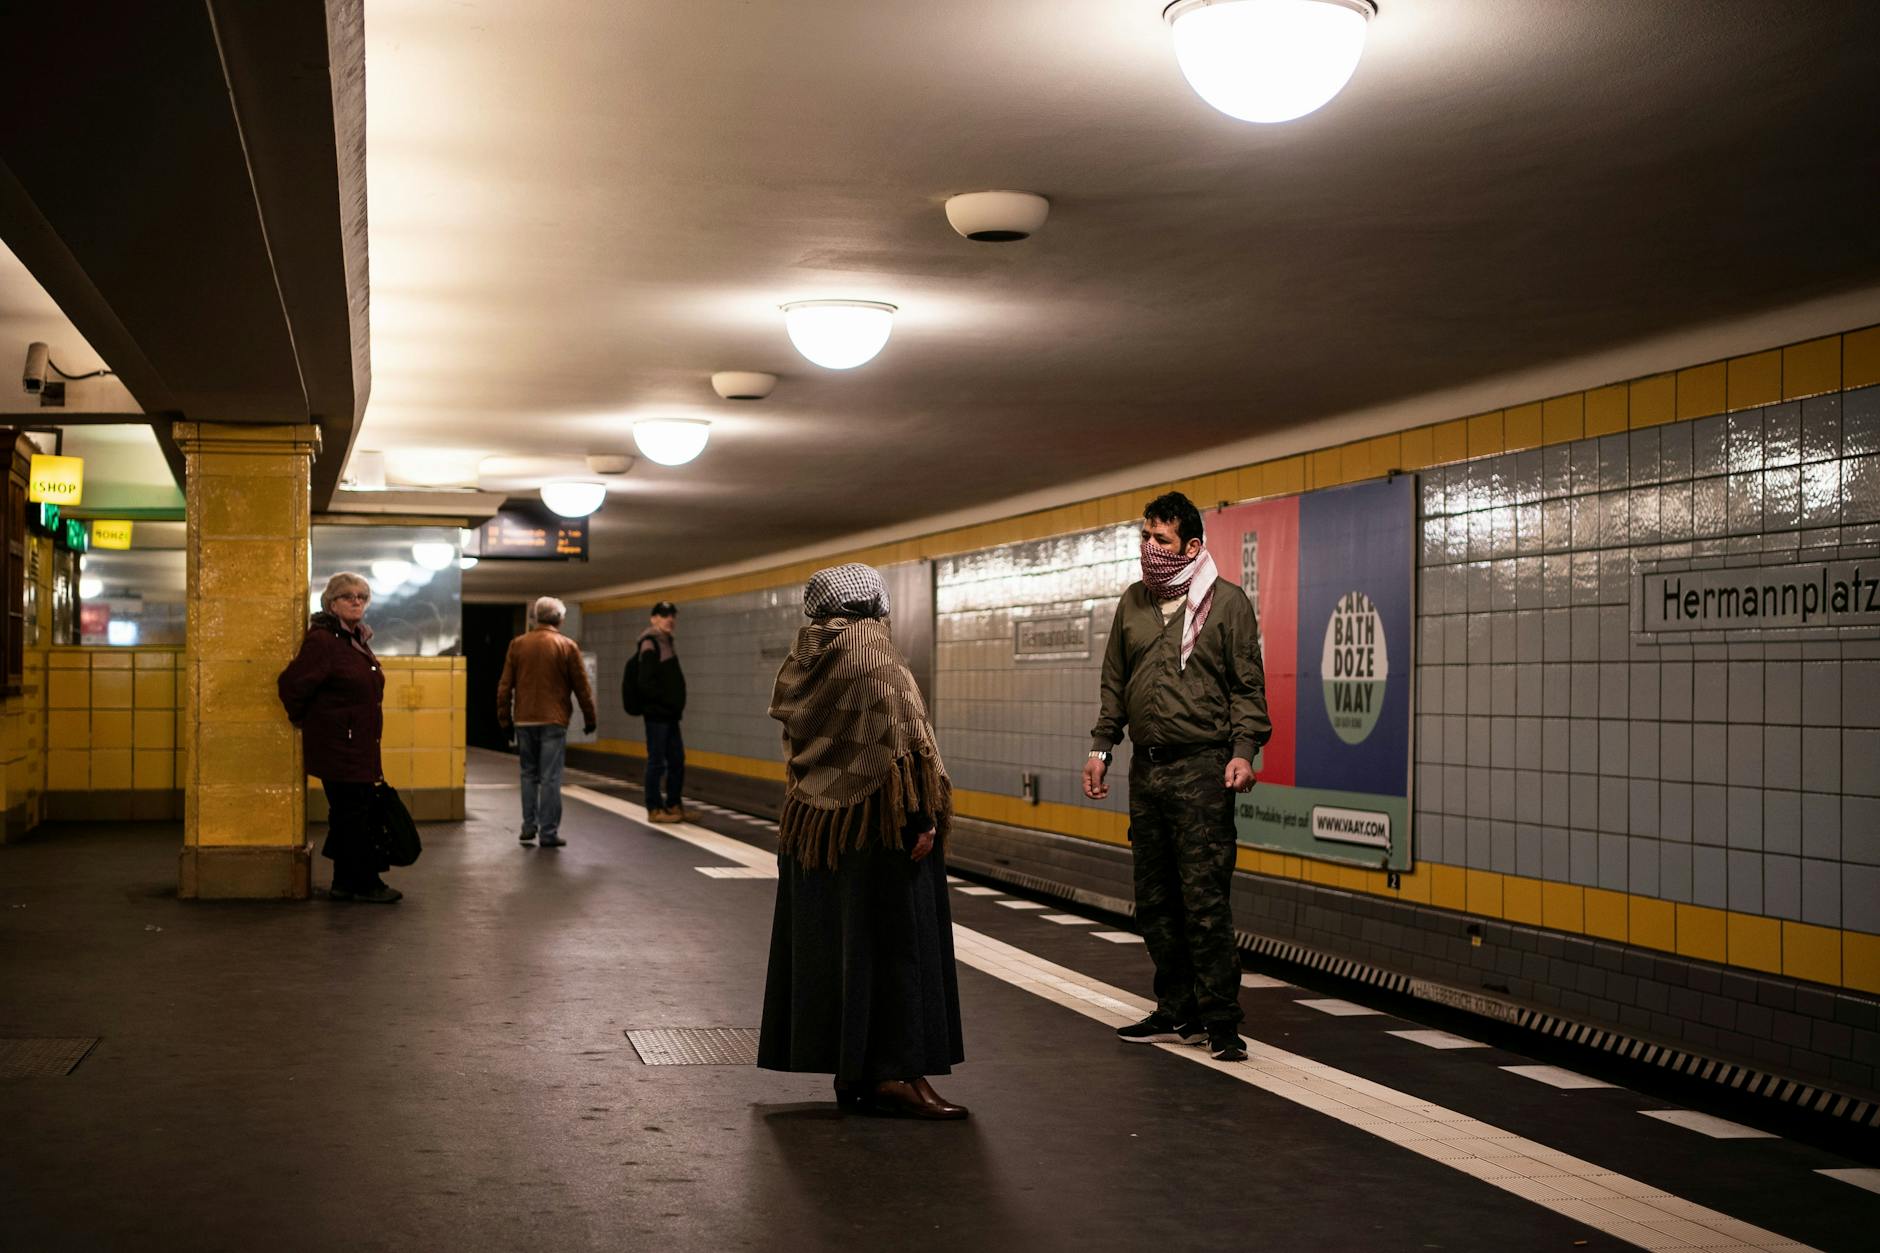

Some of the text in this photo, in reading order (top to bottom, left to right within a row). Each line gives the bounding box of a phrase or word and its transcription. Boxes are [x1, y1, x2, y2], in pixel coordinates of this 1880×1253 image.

[39, 481, 76, 495] SHOP
[1662, 566, 1880, 622] Hermannplatz
[1334, 614, 1375, 646] BATH
[1334, 647, 1374, 678] DOZE
[1333, 682, 1373, 714] VAAY
[1240, 804, 1310, 829] CBD Produkte jetzt auf
[1317, 816, 1386, 837] WWW.VAAY.COM
